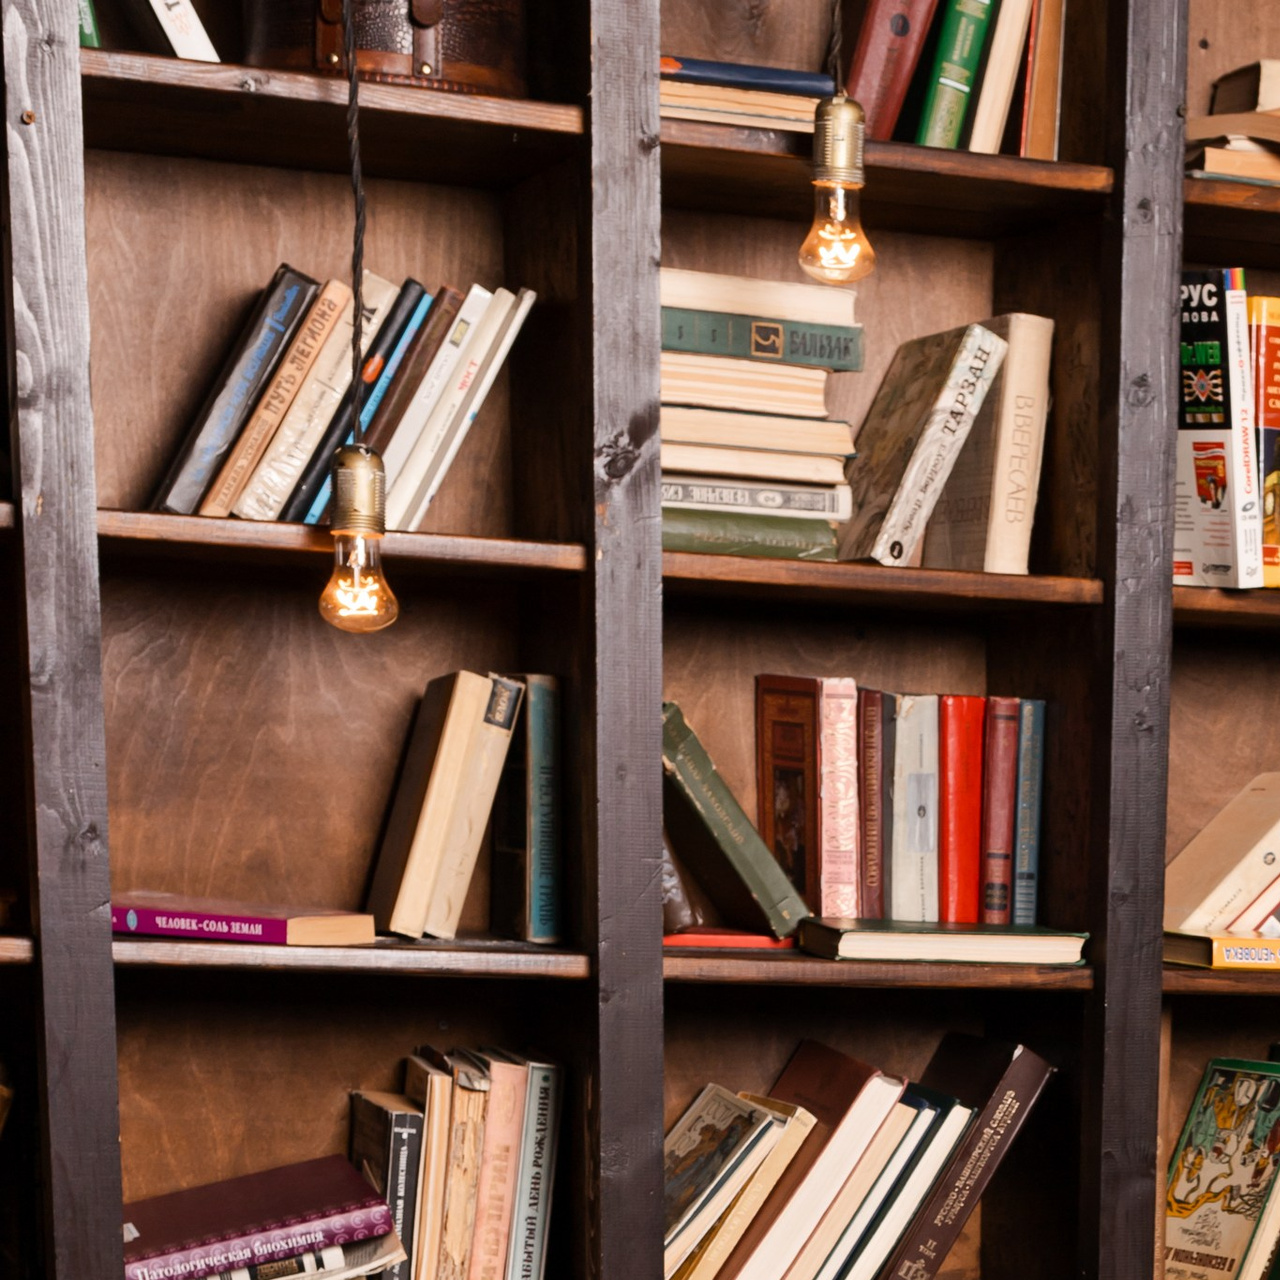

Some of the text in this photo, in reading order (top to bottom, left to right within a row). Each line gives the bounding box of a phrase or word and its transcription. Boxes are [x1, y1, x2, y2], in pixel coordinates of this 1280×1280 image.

[261, 295, 339, 416] ПУТЬ ЛЕГИОНА
[787, 329, 854, 362] БАЛЬЗАК
[937, 343, 994, 438] ТАРЗАН
[1003, 412, 1033, 524] ВЕРЕСАЕВ
[1237, 407, 1255, 495] CorelDRAW 12
[229, 920, 264, 936] ЗЕМЛИ
[1223, 943, 1277, 962] ЧЕЛОВЕКА
[530, 1084, 551, 1168] РОЖДЕНИЯ
[526, 1170, 543, 1212] ДЕНЬ
[251, 1224, 325, 1258] биохимия
